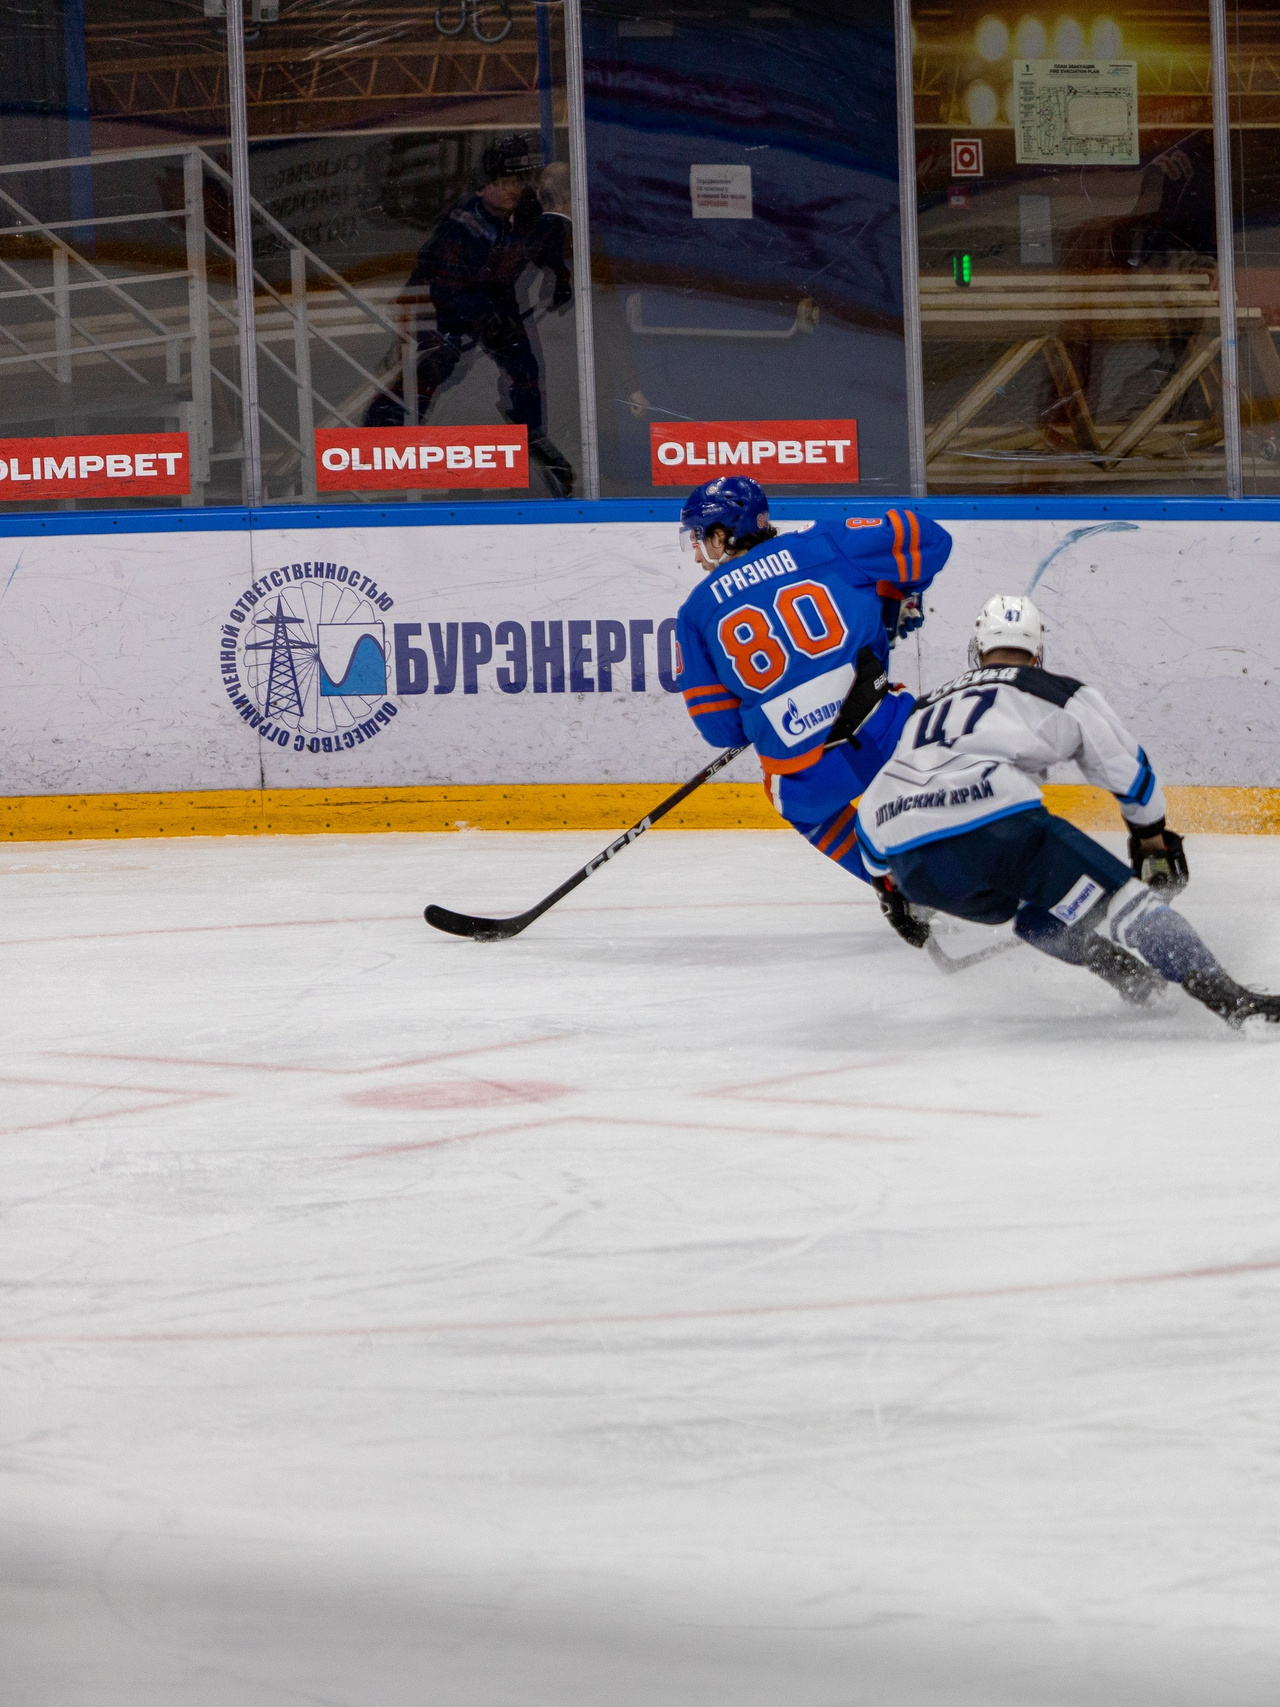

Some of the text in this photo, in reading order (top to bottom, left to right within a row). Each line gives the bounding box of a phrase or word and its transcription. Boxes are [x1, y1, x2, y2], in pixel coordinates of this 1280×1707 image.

[321, 445, 522, 471] OLIMPBET
[657, 439, 851, 466] OLIMPBET
[229, 561, 395, 624] ОТВЕТСТВЕННОСТЬЮ
[709, 549, 799, 604] ГРЯЗНОВ
[717, 578, 850, 695] 80
[1004, 609, 1021, 623] 47
[393, 618, 684, 696] БУРЭНЕРГО
[220, 623, 291, 747] ОГРАНИЧЕННОЙ
[310, 701, 398, 754] ОБЩЕСТВО
[803, 698, 847, 729] ГАЗПРО
[585, 815, 652, 876] CCM
